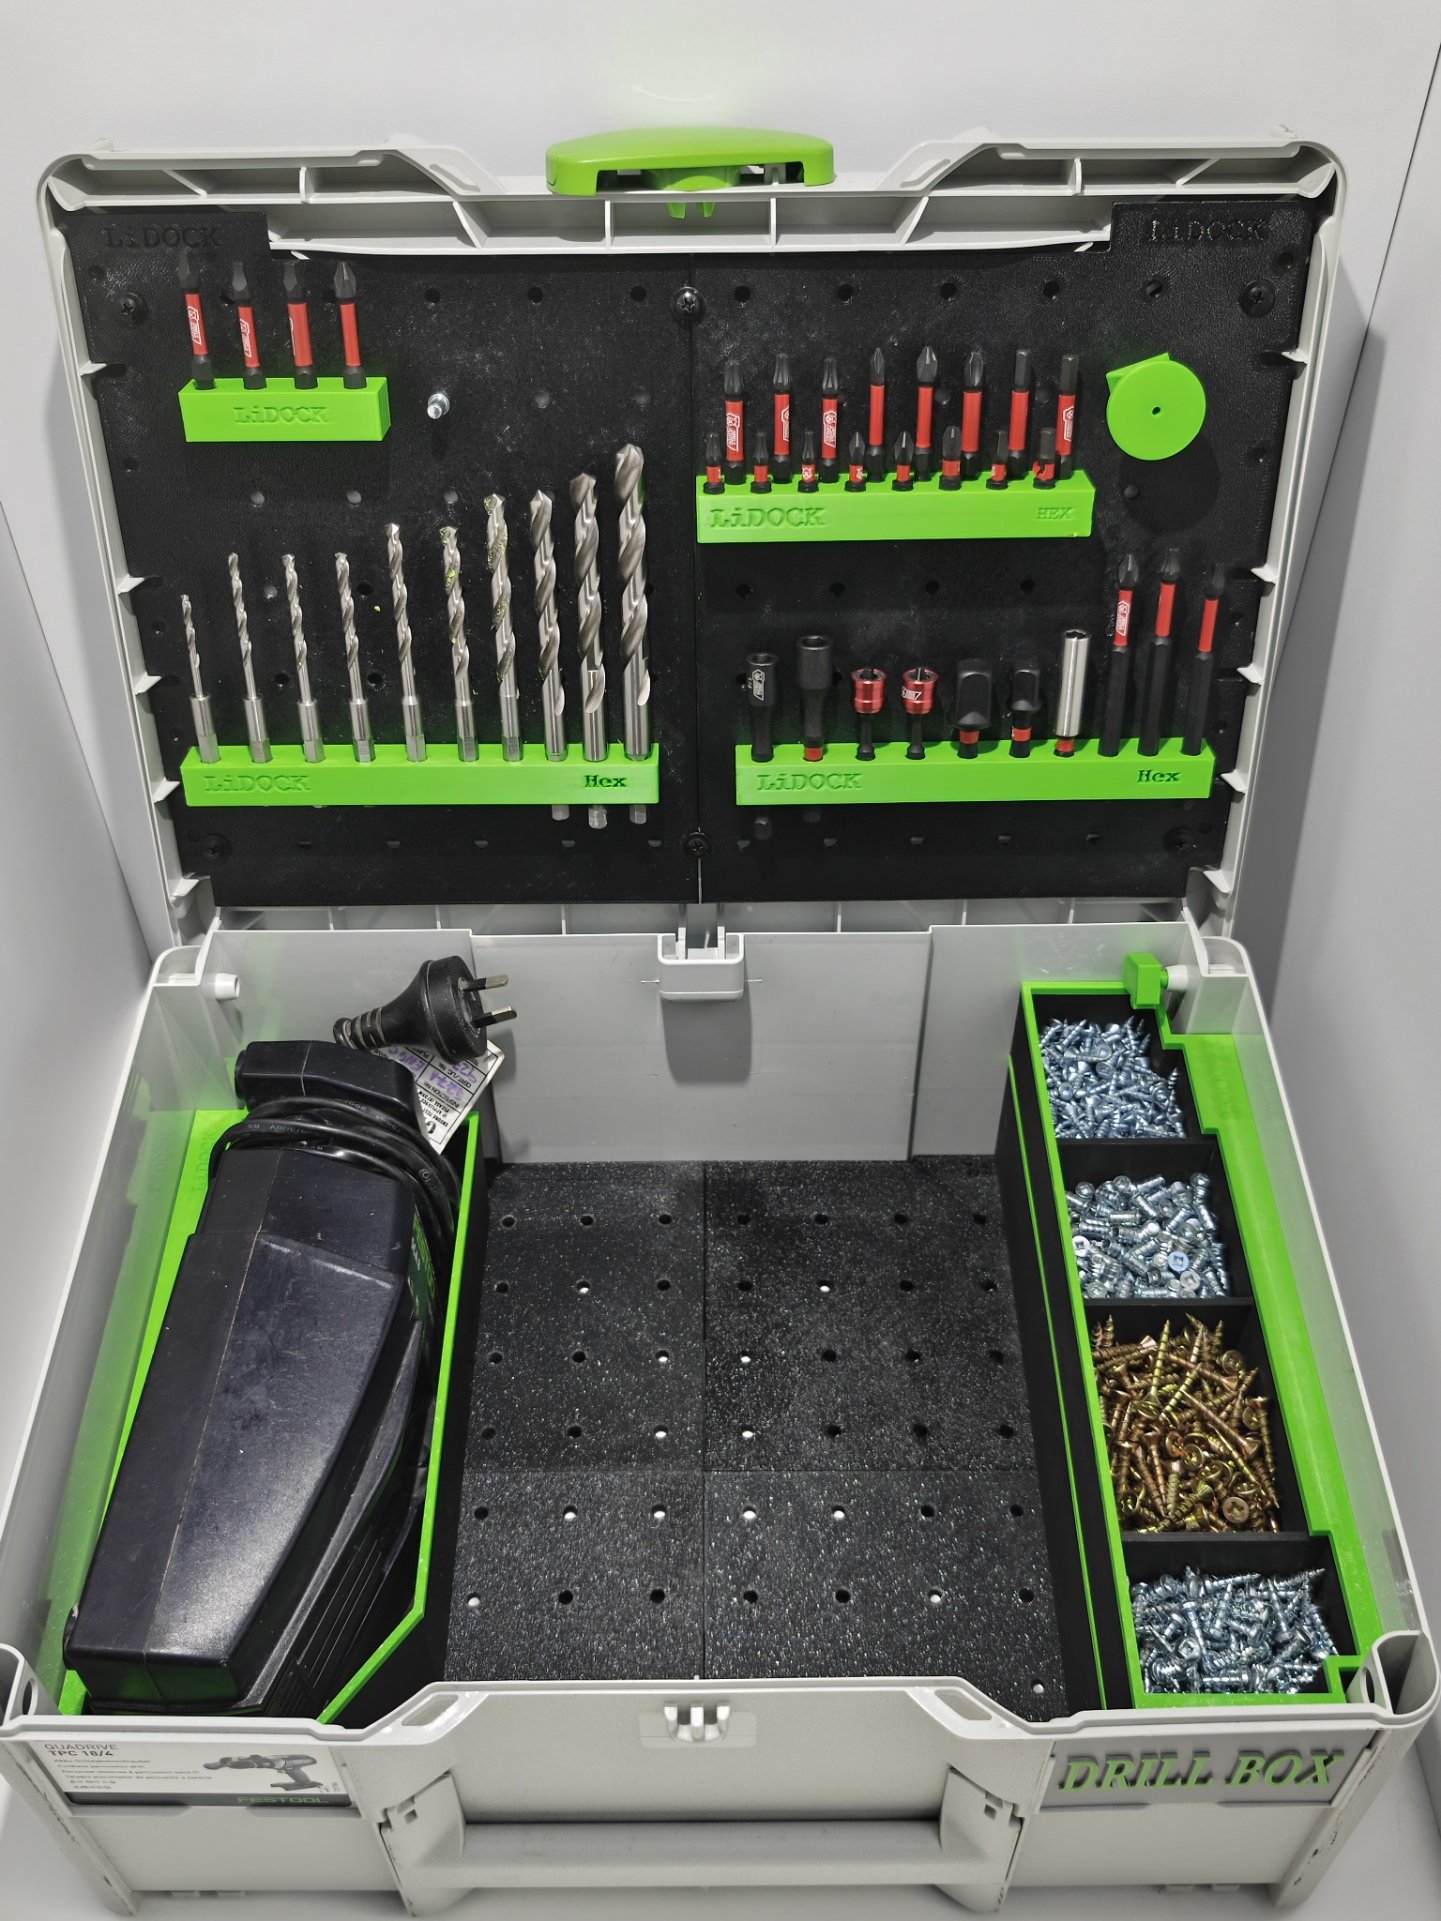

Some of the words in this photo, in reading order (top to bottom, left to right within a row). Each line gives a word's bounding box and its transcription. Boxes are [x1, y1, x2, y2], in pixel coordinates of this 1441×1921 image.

[232, 406, 330, 425] LiDOCK
[709, 507, 826, 528] LiDOCK
[1037, 507, 1074, 520] HEX
[203, 775, 311, 792] LiDOCK
[583, 774, 629, 789] Hex
[756, 773, 864, 791] LiDOCK
[1136, 769, 1182, 784] Hex
[44, 1743, 119, 1751] QUADRIVE
[1058, 1753, 1213, 1793] DRILL
[1224, 1750, 1345, 1788] BOX
[237, 1796, 329, 1804] FESTOOL
